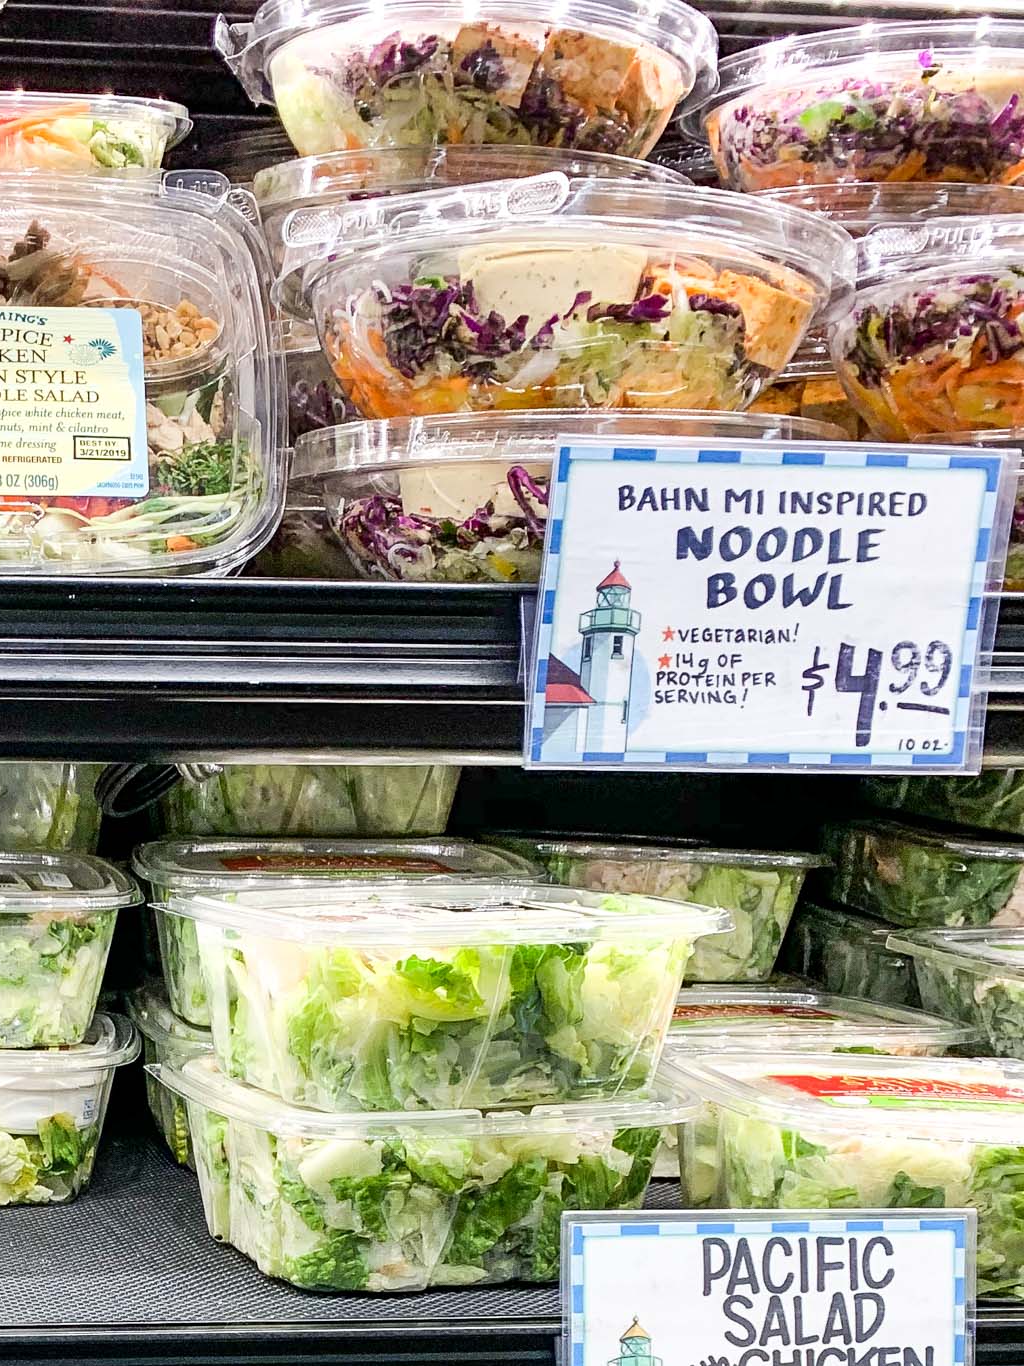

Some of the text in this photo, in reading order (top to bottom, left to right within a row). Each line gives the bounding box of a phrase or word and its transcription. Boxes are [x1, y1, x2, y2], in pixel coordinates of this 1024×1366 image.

[25, 408, 52, 419] white
[55, 408, 93, 419] chicken
[96, 410, 125, 421] meat,
[619, 485, 928, 517] BAHN MI INSPIRED
[676, 526, 886, 564] NOODLE
[707, 572, 853, 610] BOWL
[656, 671, 776, 687] PROTEIN PER
[655, 689, 748, 708] SERVING!
[703, 1237, 895, 1296] PACIFIC
[723, 1293, 885, 1347] SALAD
